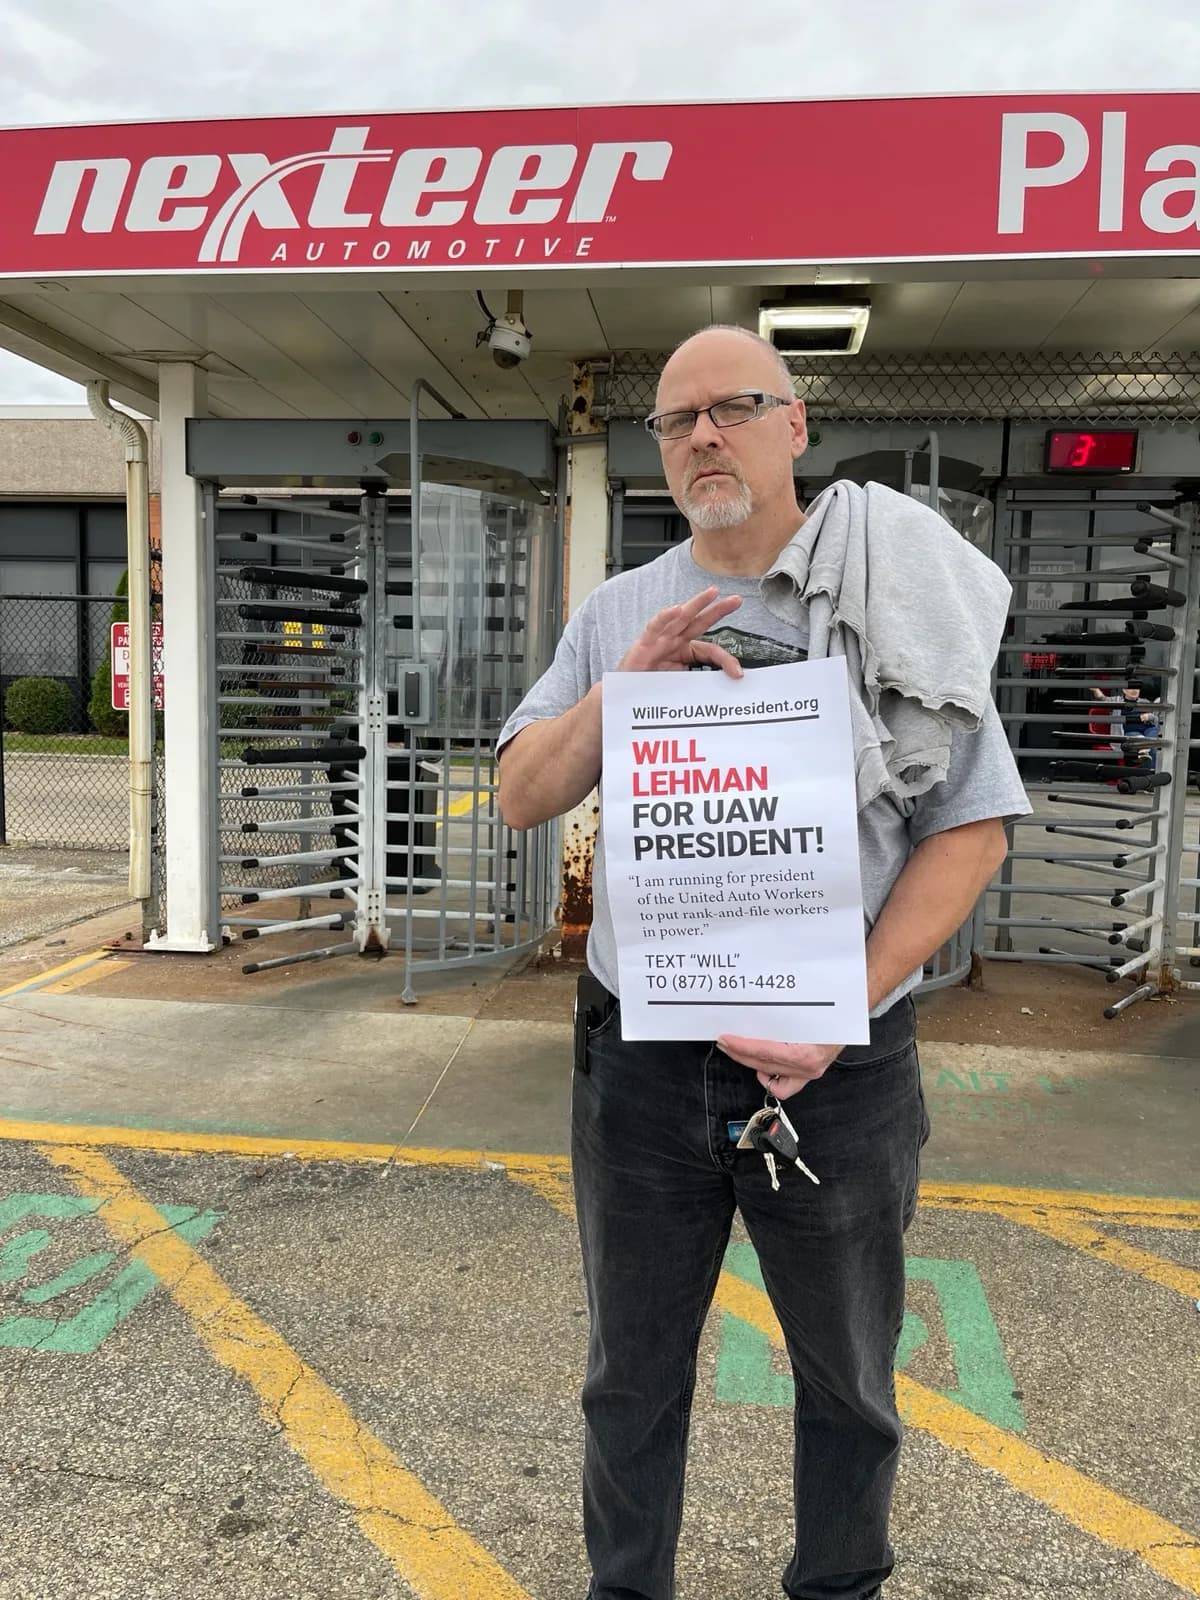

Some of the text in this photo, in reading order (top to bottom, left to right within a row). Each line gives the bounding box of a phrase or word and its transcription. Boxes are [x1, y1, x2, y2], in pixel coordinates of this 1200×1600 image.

[997, 111, 1200, 234] Pla
[33, 126, 673, 262] nexteer
[270, 236, 595, 262] AUTOMOTIVE
[1071, 434, 1096, 467] 3
[632, 698, 819, 720] WillForUAWpresident.org
[632, 738, 706, 765] WILL
[632, 766, 768, 797] LEHMAN
[633, 796, 779, 828] FOR UAW
[634, 826, 824, 861] PRESIDENT!
[644, 878, 664, 887] am
[669, 874, 723, 888] running
[727, 870, 746, 885] for
[750, 869, 815, 886] president
[637, 888, 825, 905] of the United Auto Workers
[640, 904, 829, 923] to put rank-and-file workers
[643, 926, 656, 938] in
[645, 955, 686, 969] TEXT
[646, 974, 796, 992] TO (877) 861-4428
